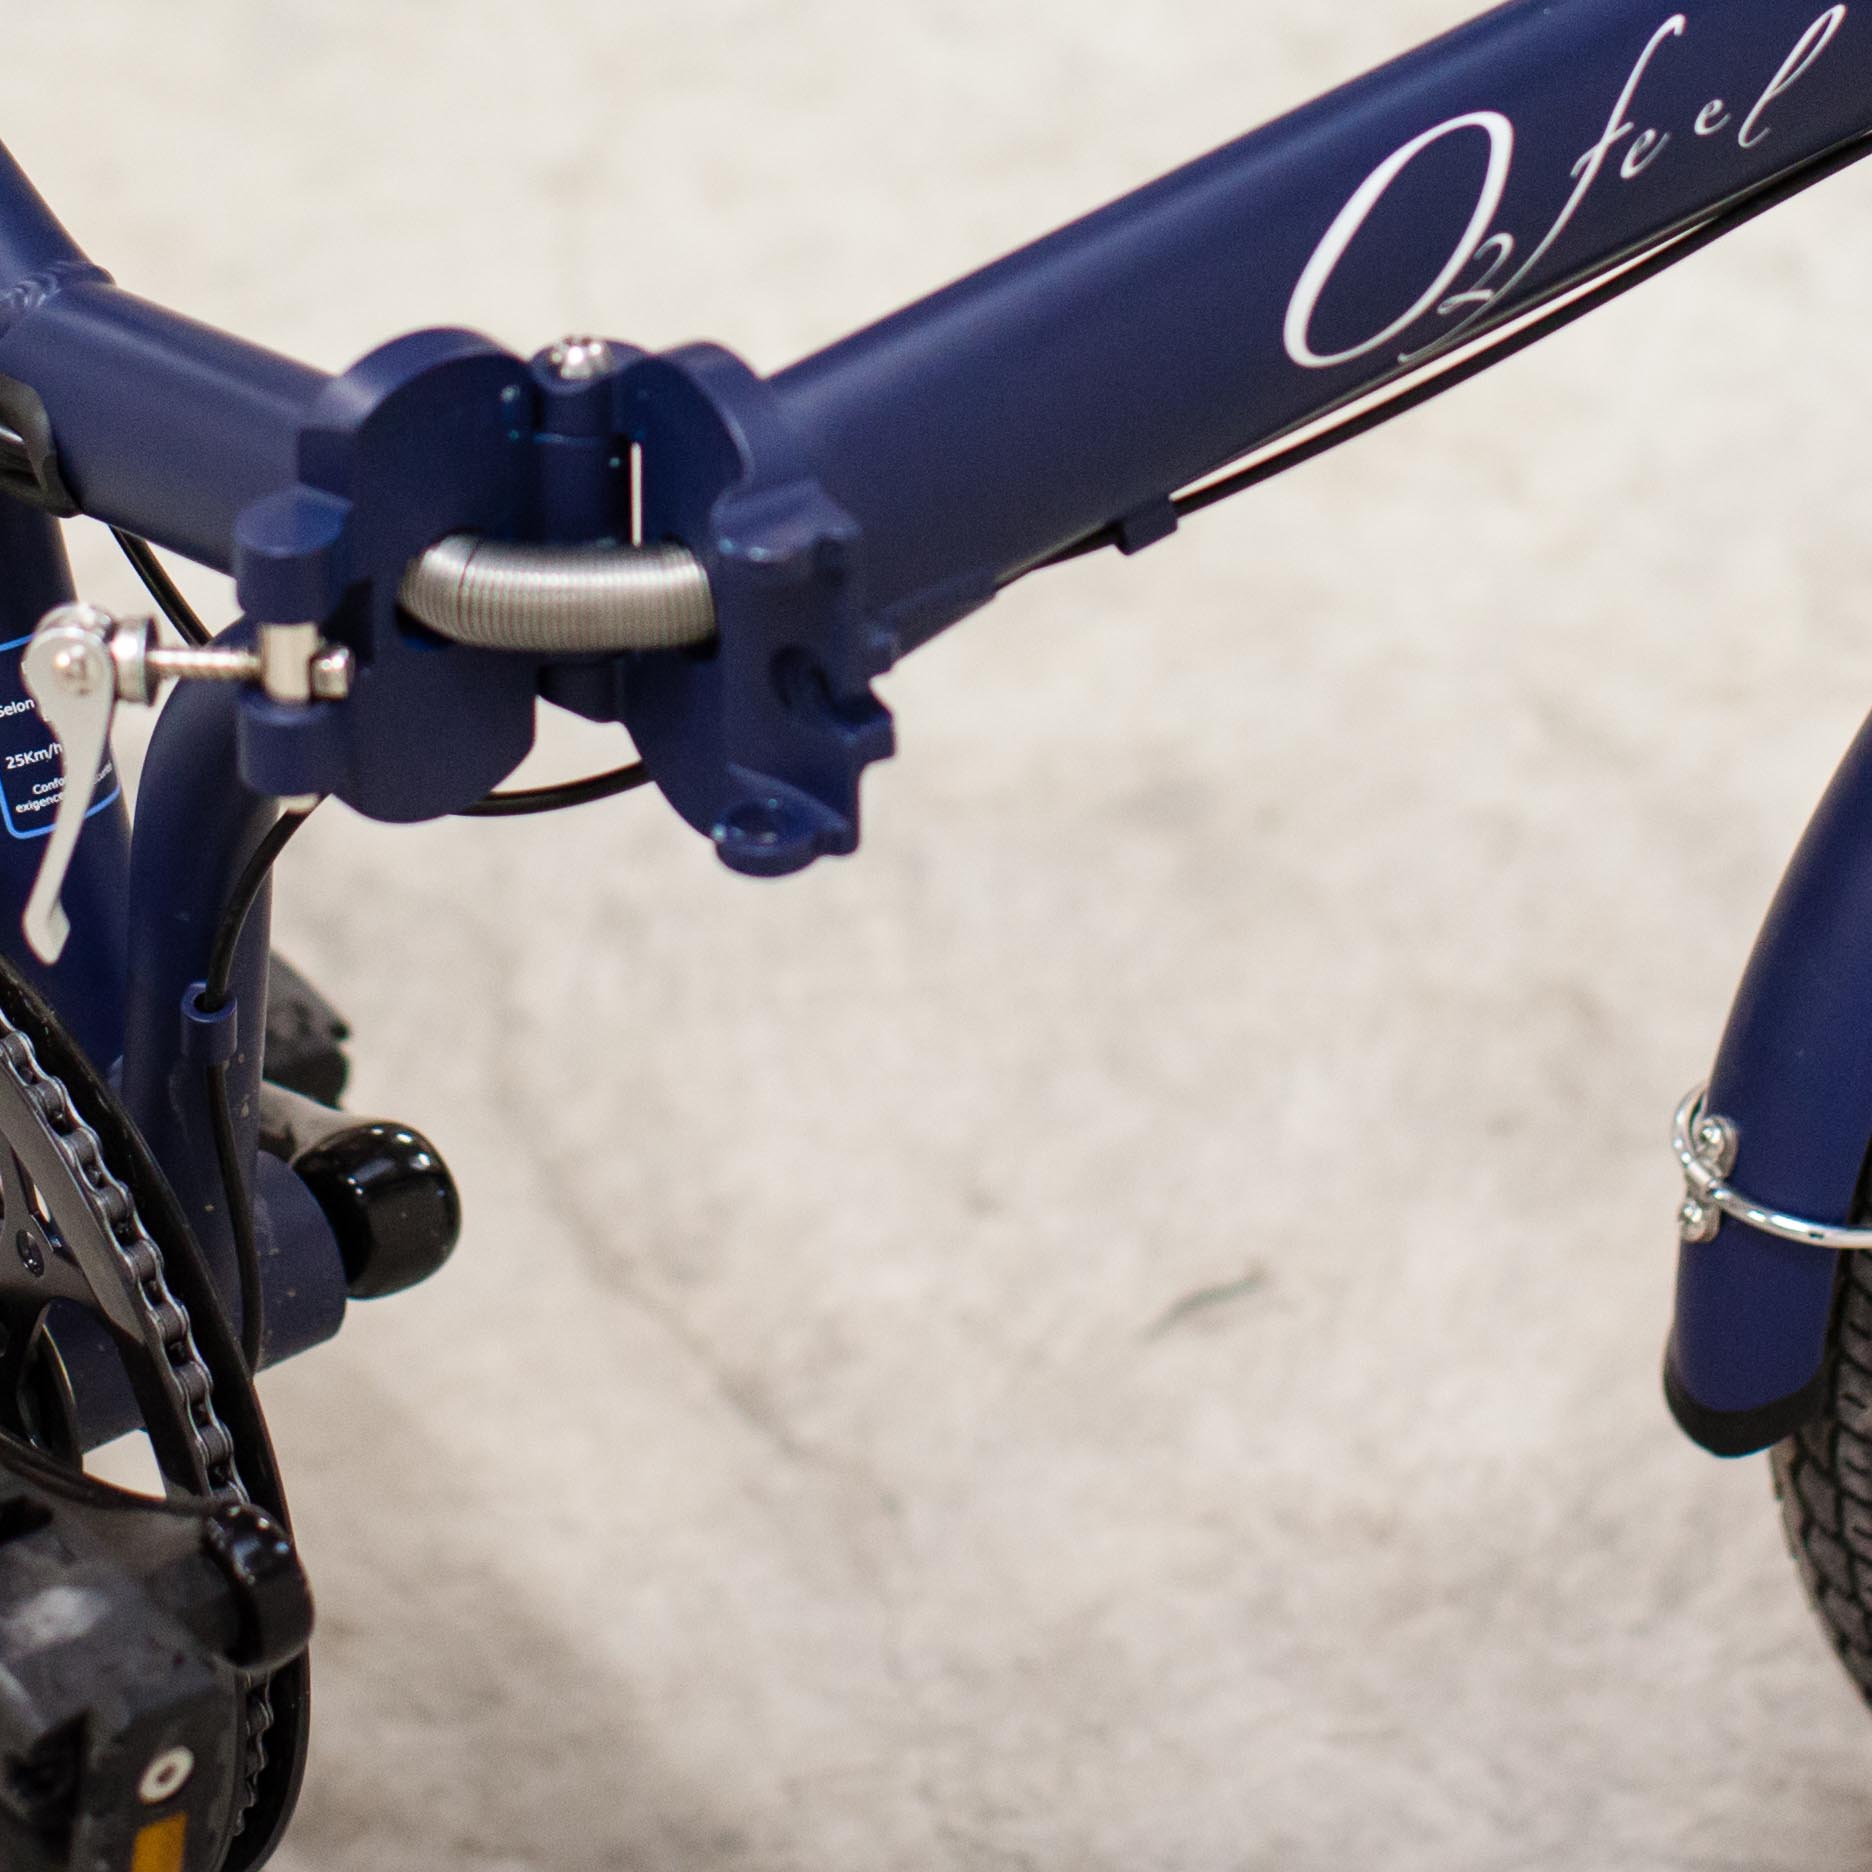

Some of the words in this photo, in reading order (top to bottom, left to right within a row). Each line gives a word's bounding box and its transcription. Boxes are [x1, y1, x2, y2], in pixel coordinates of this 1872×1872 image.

[5, 742, 63, 770] 25Km/h
[32, 776, 65, 795] Confo
[15, 792, 65, 814] exigence
